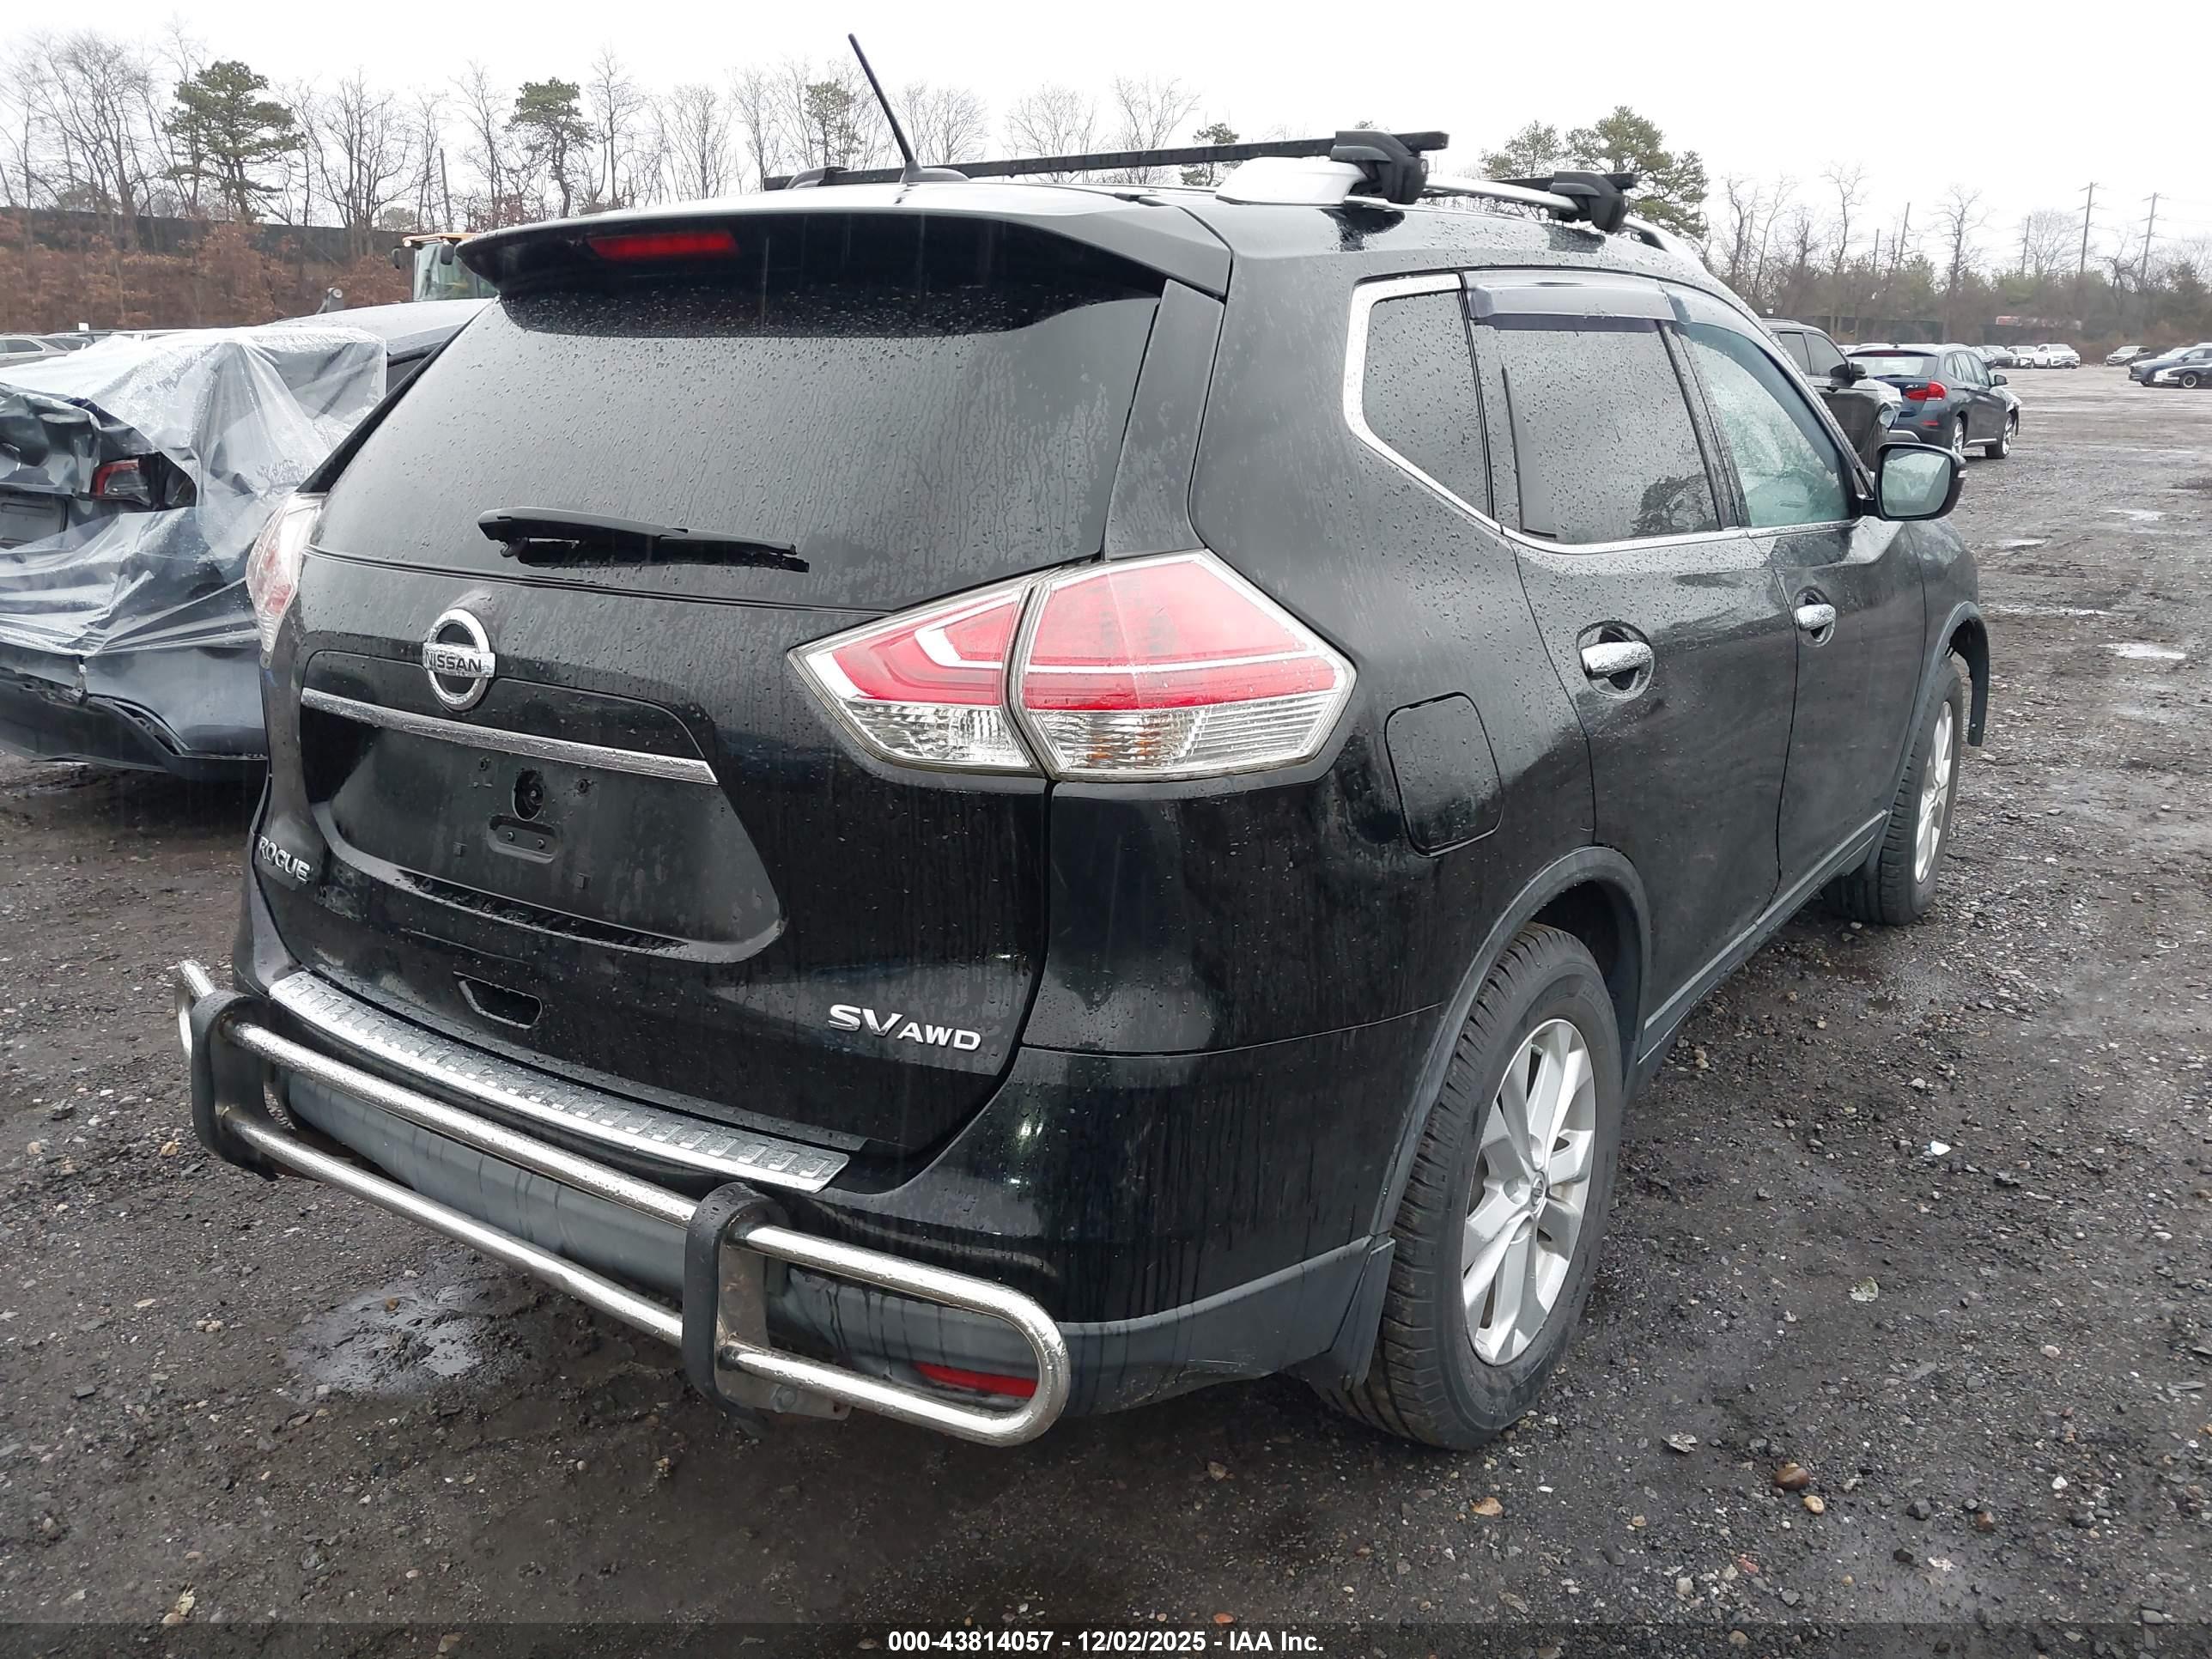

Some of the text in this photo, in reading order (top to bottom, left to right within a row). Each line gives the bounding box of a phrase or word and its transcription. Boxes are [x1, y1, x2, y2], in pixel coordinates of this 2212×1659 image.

[425, 650, 482, 673] NISSAN
[258, 836, 310, 883] ROGUE
[828, 1004, 981, 1051] SV AWD
